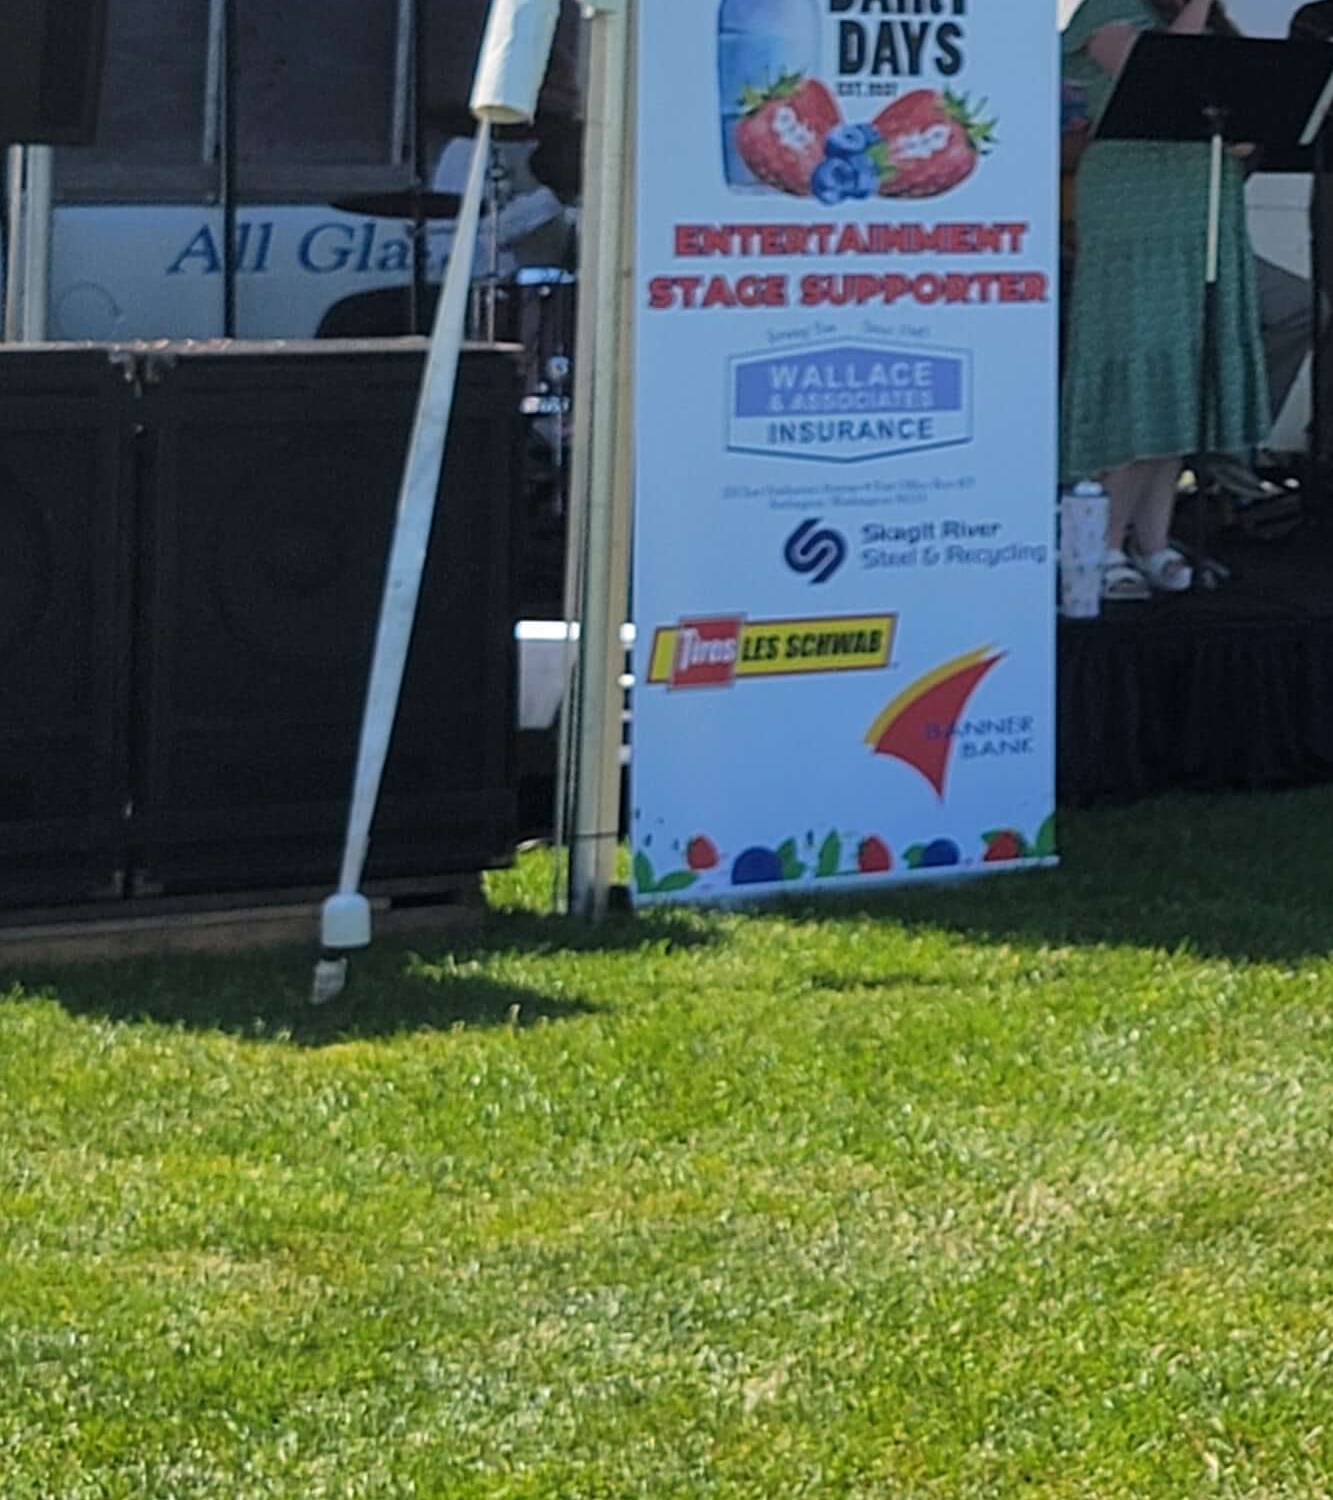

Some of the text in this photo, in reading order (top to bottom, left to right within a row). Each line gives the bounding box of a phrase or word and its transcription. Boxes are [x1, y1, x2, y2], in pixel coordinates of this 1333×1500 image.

[838, 21, 964, 76] DAYS
[166, 221, 274, 275] All
[674, 221, 1029, 258] ENTERTAINMENT
[648, 270, 1049, 309] STAGE SUPPORTER
[769, 361, 934, 389] WALLACE
[768, 417, 935, 445] INSURANCE
[861, 519, 1002, 544] Skagit River
[862, 546, 918, 569] Steel
[946, 543, 1049, 567] Recycling
[741, 634, 779, 662] LES
[785, 628, 884, 658] SCHWAB
[925, 715, 1035, 741] BANNER
[960, 738, 1035, 759] BANK
